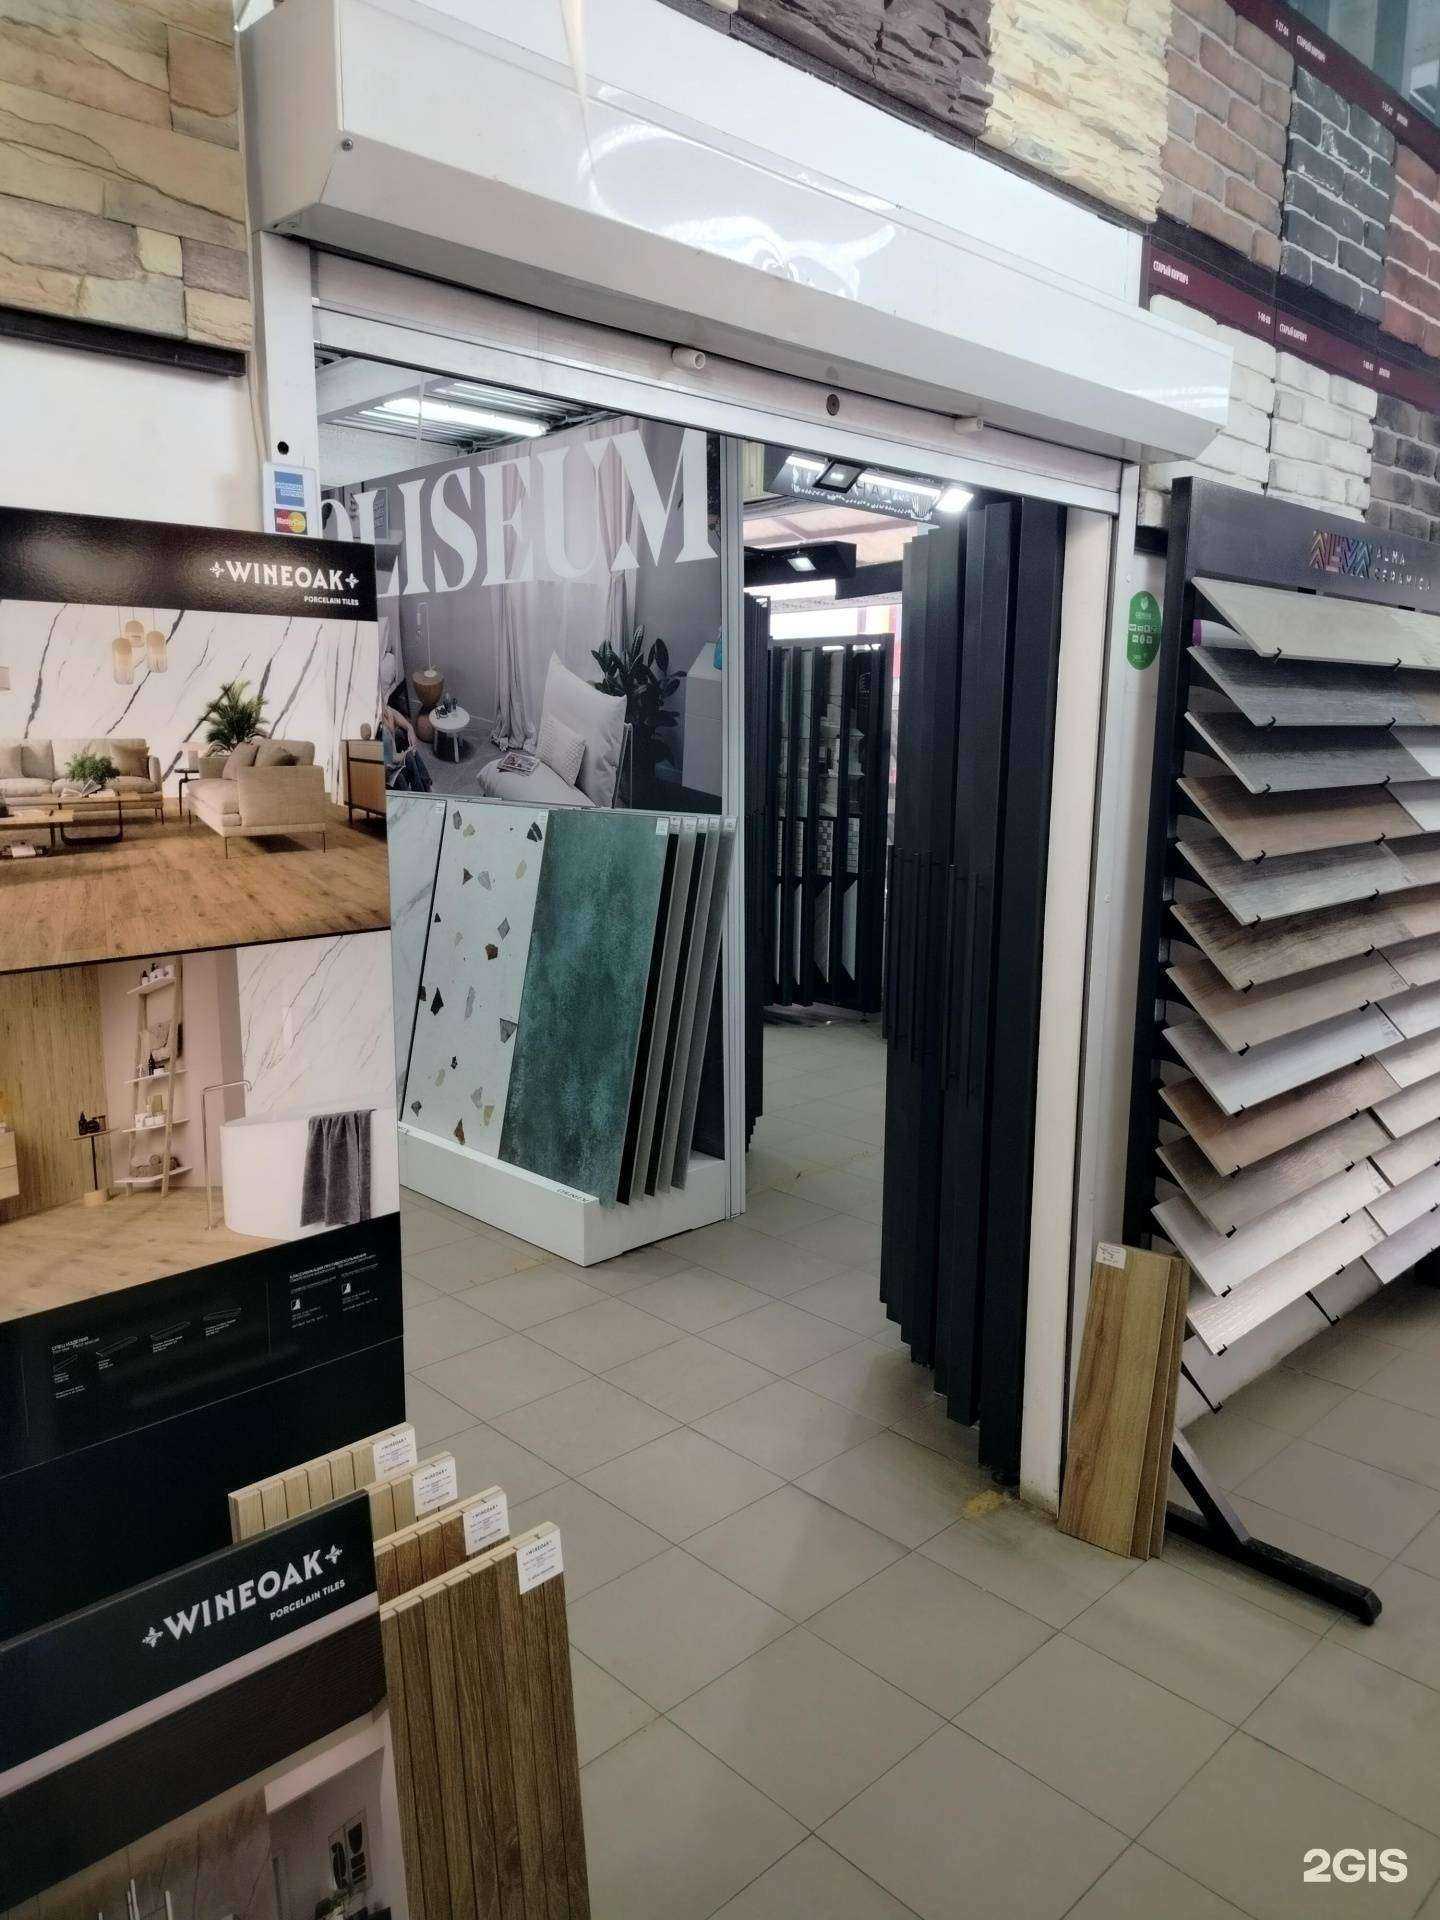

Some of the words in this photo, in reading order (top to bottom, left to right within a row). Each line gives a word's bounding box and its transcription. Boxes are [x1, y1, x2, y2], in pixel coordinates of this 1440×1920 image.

[225, 559, 344, 591] WINEOAK
[304, 595, 341, 604] PORCELAIN
[342, 597, 359, 606] TILES
[163, 1549, 324, 1641] WINEOAK
[270, 1589, 321, 1621] PORCELAIN
[321, 1579, 346, 1596] TILES
